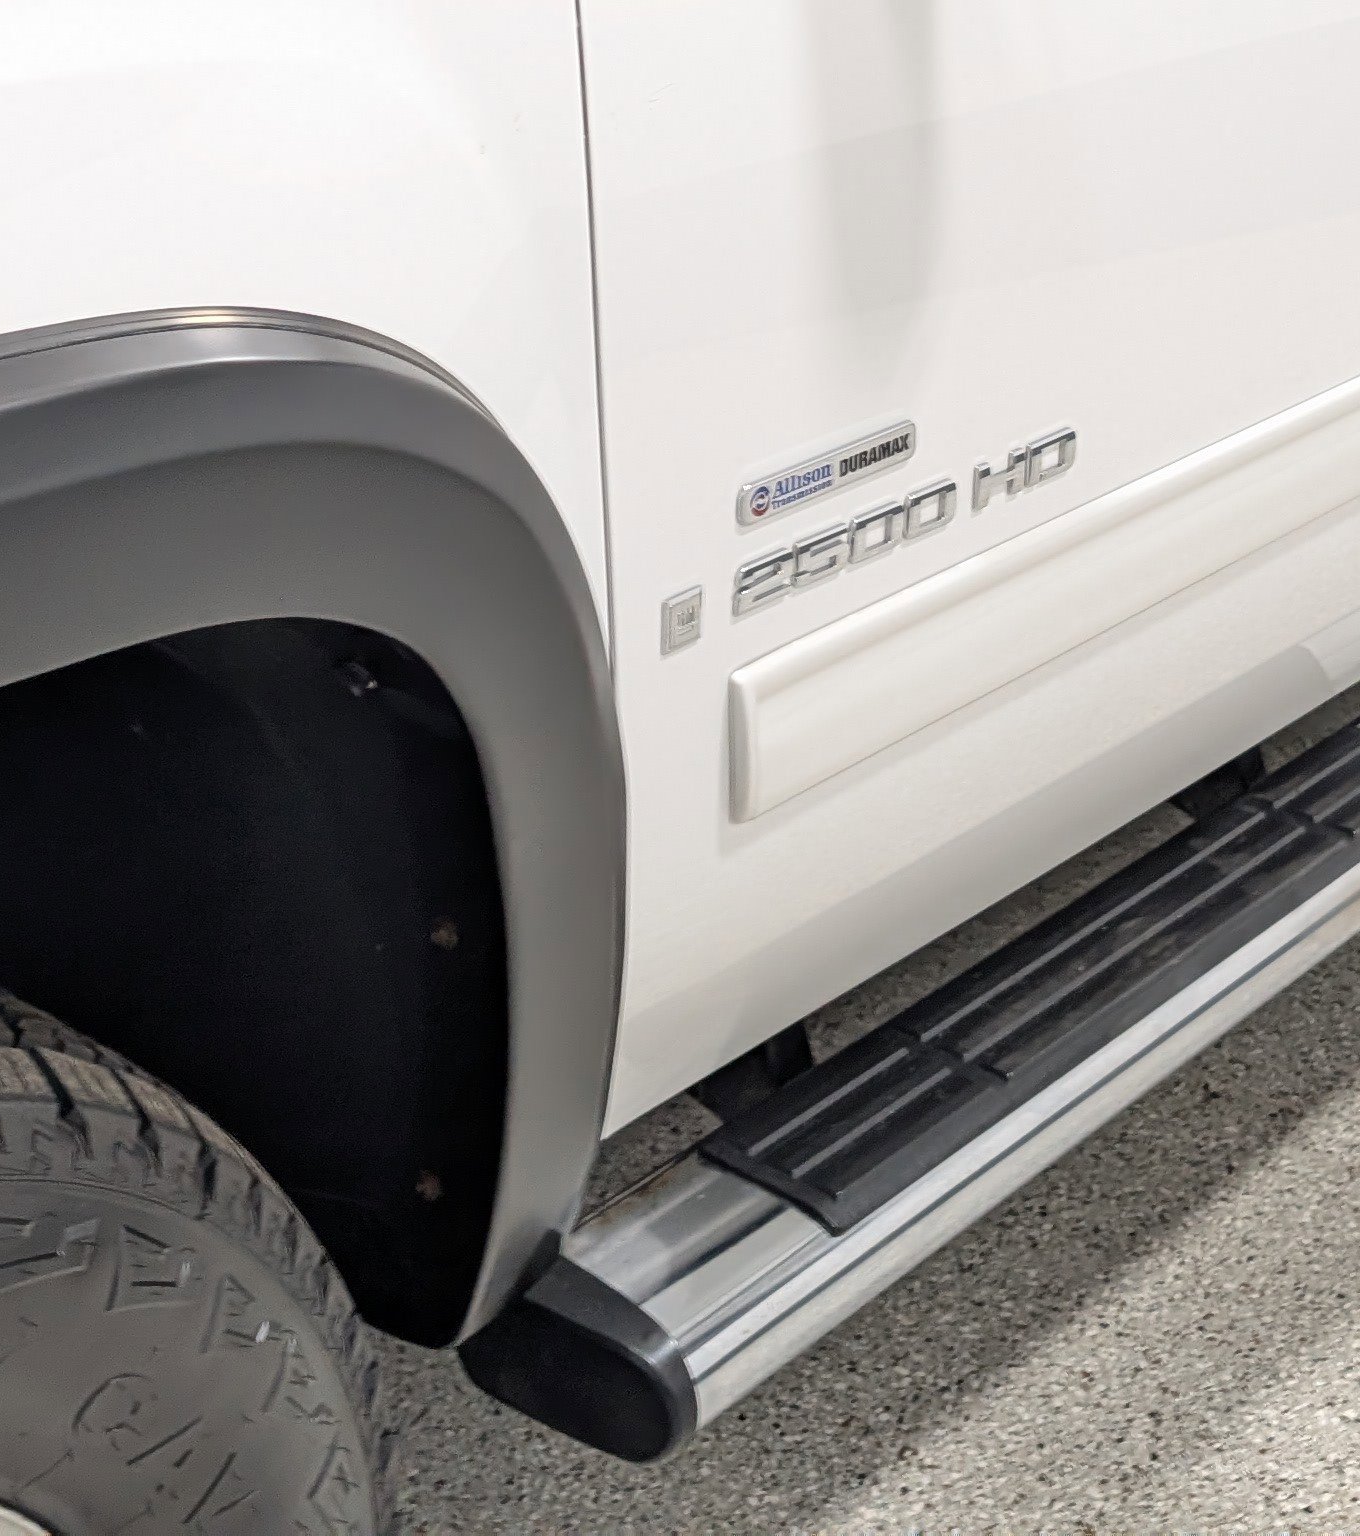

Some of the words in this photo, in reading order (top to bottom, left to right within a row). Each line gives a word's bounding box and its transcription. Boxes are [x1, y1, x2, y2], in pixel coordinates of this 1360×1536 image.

[838, 432, 911, 478] DURAMAX
[772, 463, 833, 499] Allison
[731, 478, 958, 617] 2500
[970, 427, 1078, 513] HD
